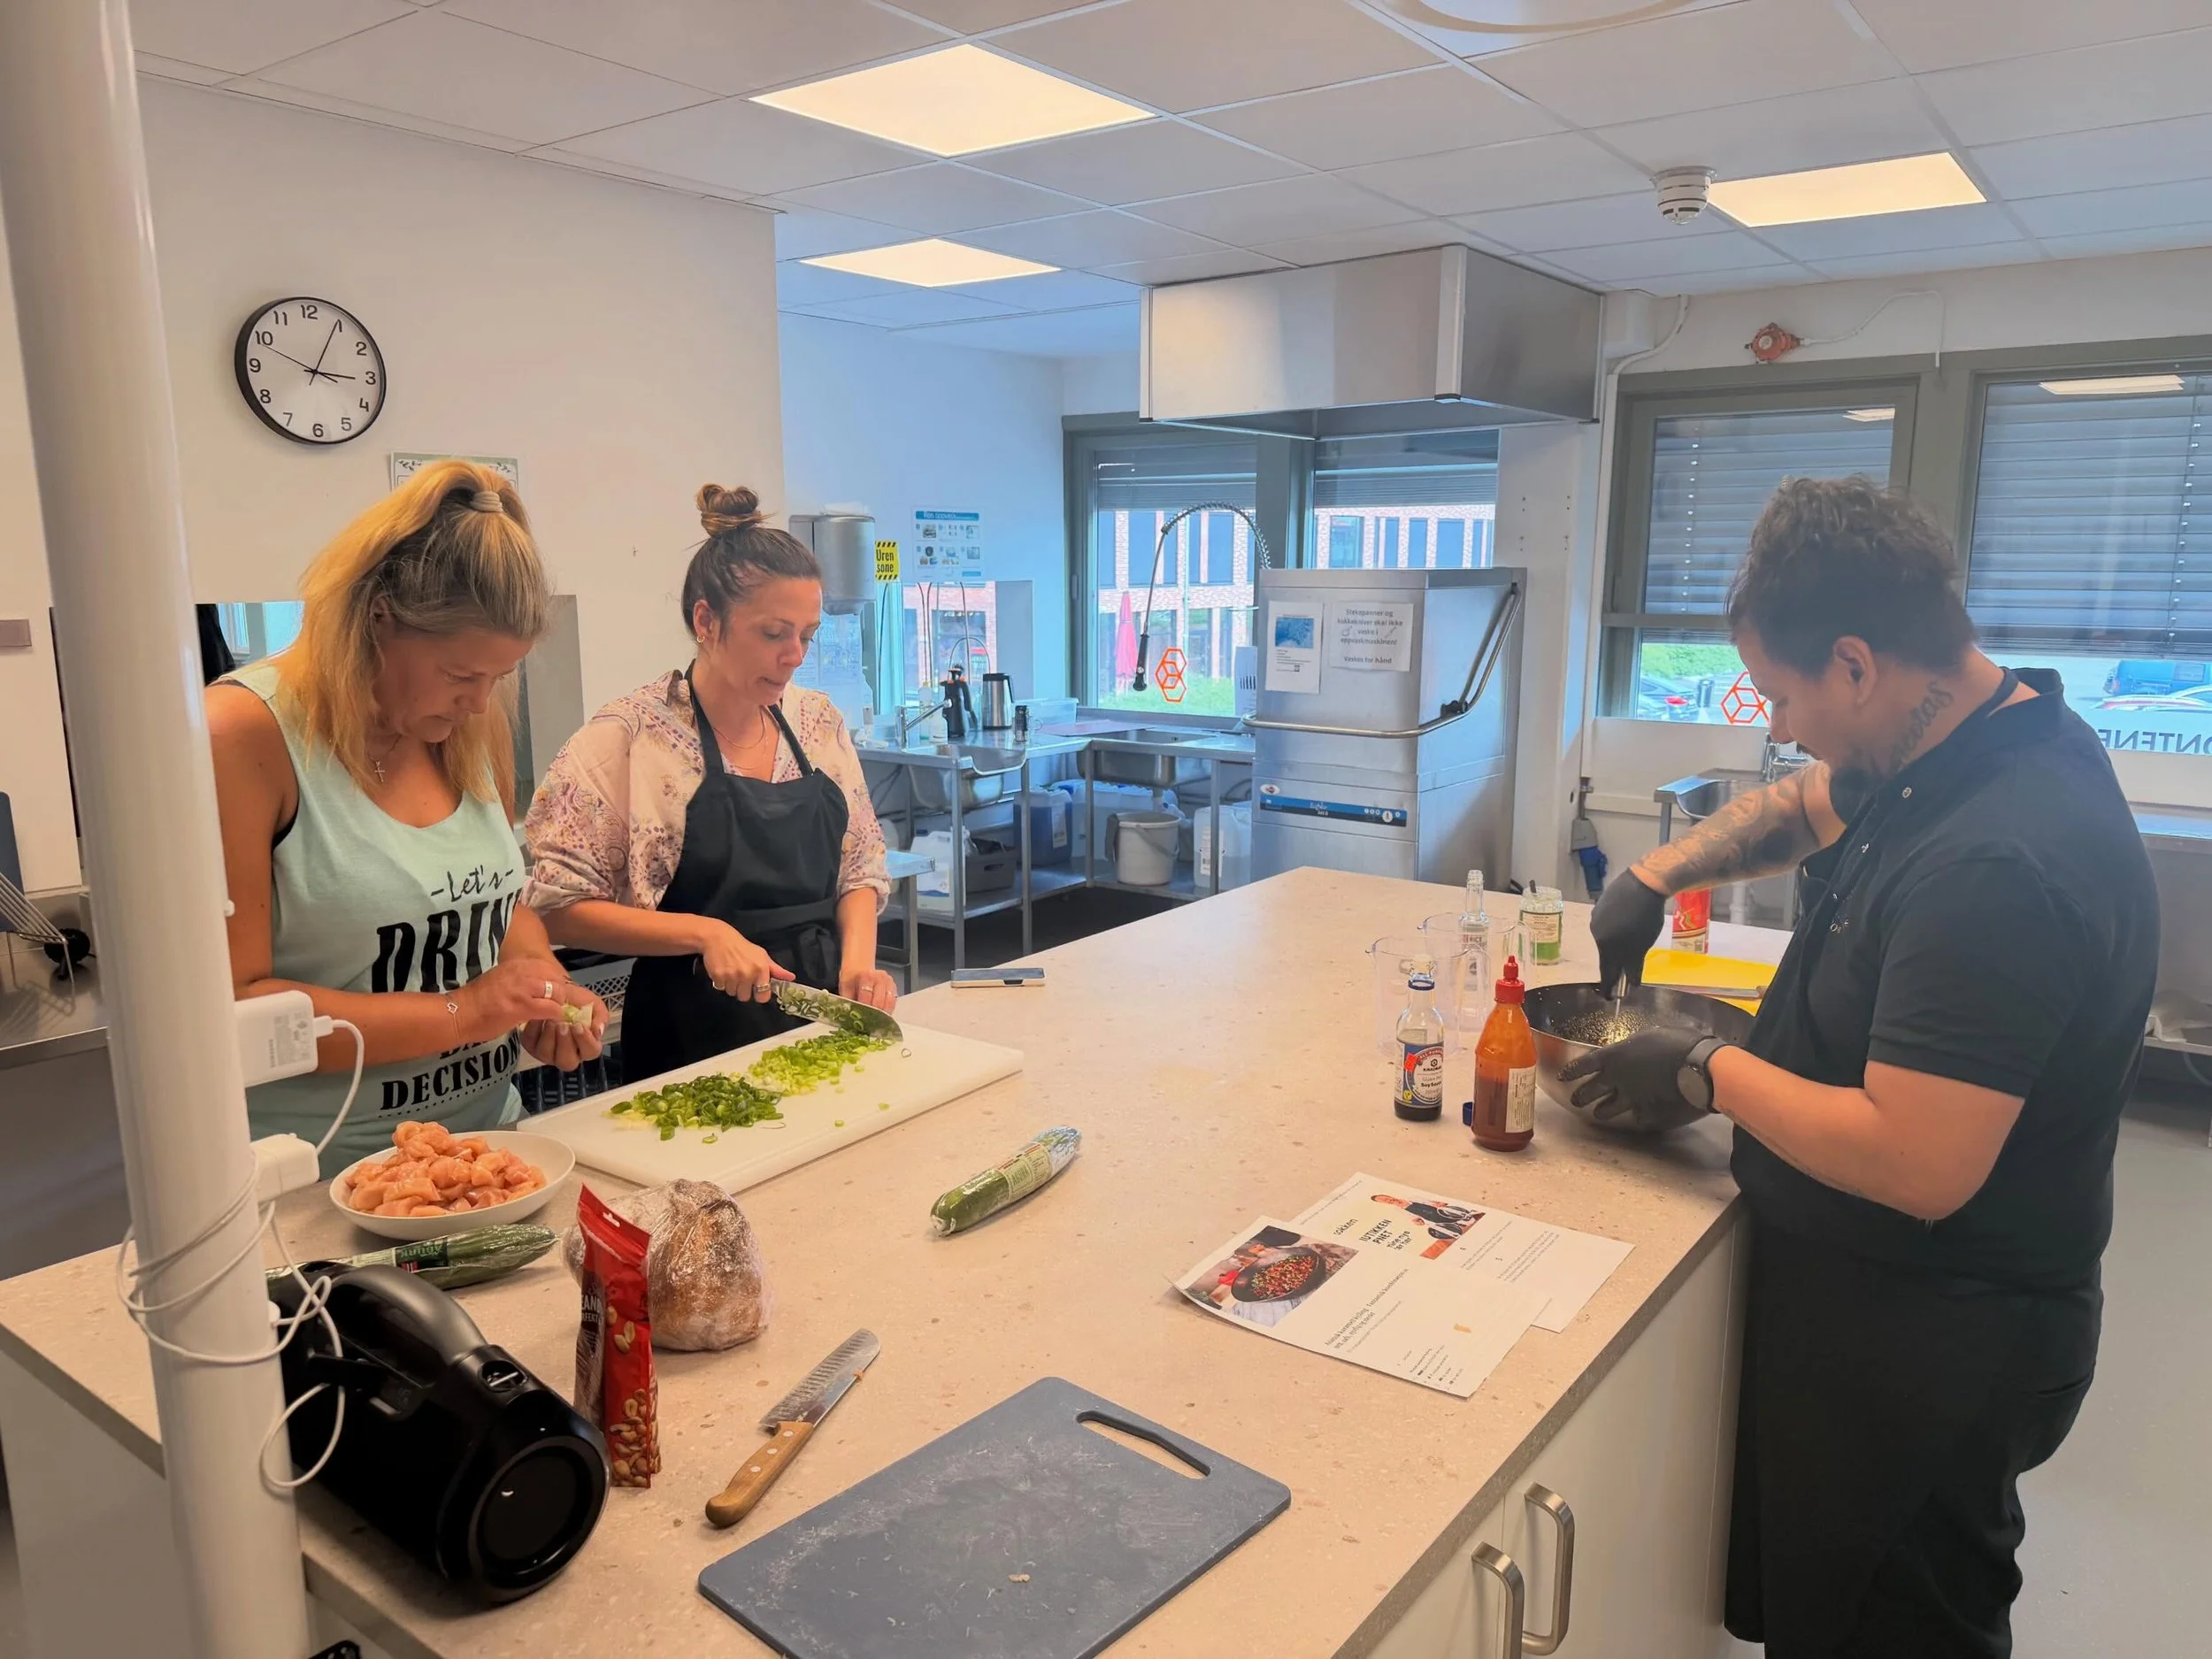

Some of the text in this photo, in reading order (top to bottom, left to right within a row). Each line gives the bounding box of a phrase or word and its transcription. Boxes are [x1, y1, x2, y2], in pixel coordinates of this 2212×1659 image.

[273, 311, 288, 326] 11
[301, 304, 318, 319] 12
[336, 319, 342, 333] 1
[255, 330, 273, 346] 10
[356, 342, 367, 356] 2
[249, 357, 261, 373] 9
[365, 371, 376, 385] 3
[259, 388, 272, 403] 8
[359, 397, 369, 411] 4
[282, 412, 293, 426] 7
[341, 417, 352, 431] 5
[312, 423, 324, 437] 6
[876, 549, 894, 562] Uren
[876, 562, 894, 573] sone
